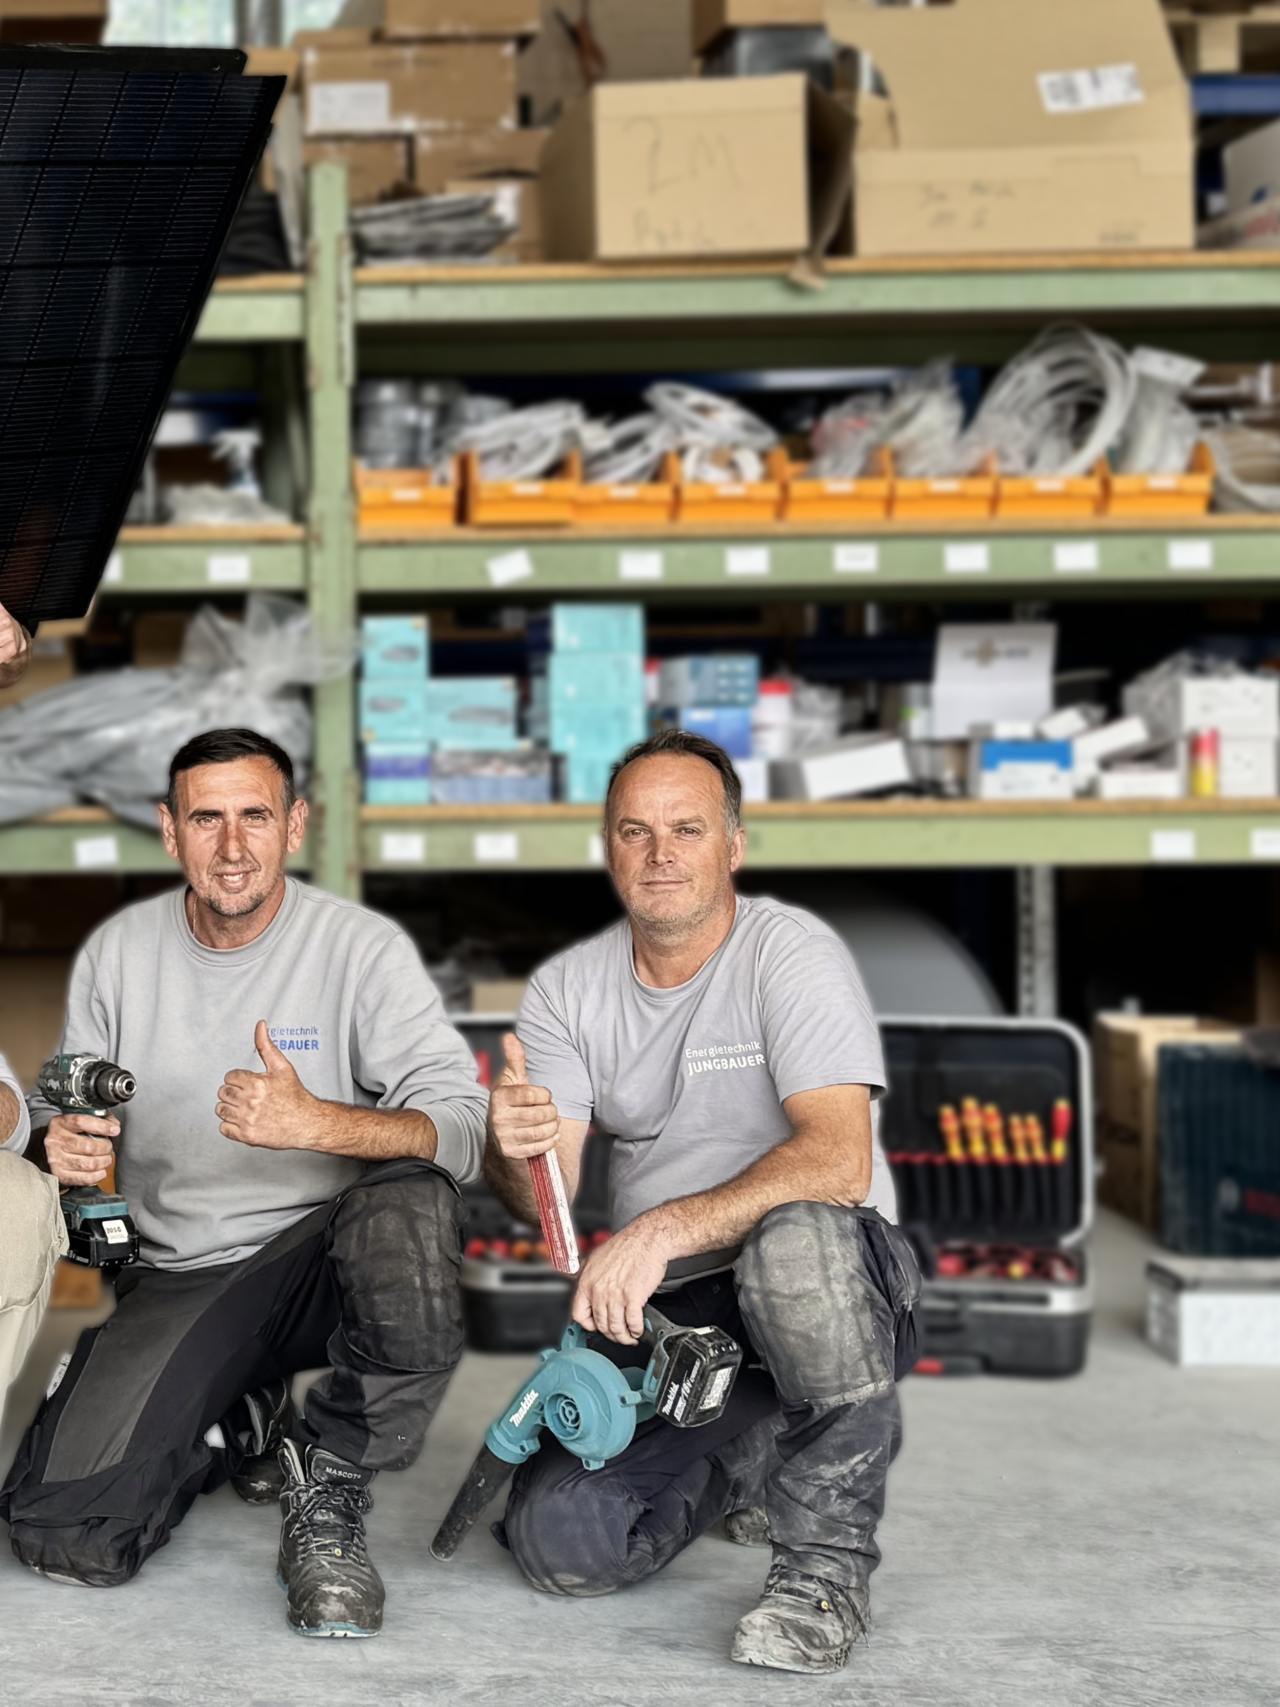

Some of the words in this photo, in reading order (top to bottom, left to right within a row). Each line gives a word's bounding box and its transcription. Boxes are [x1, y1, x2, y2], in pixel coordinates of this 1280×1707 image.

[269, 1026, 319, 1037] gietechnik
[273, 1040, 319, 1051] BAUER
[685, 1041, 761, 1059] Energietechnik
[687, 1053, 766, 1076] JUNGBAUER
